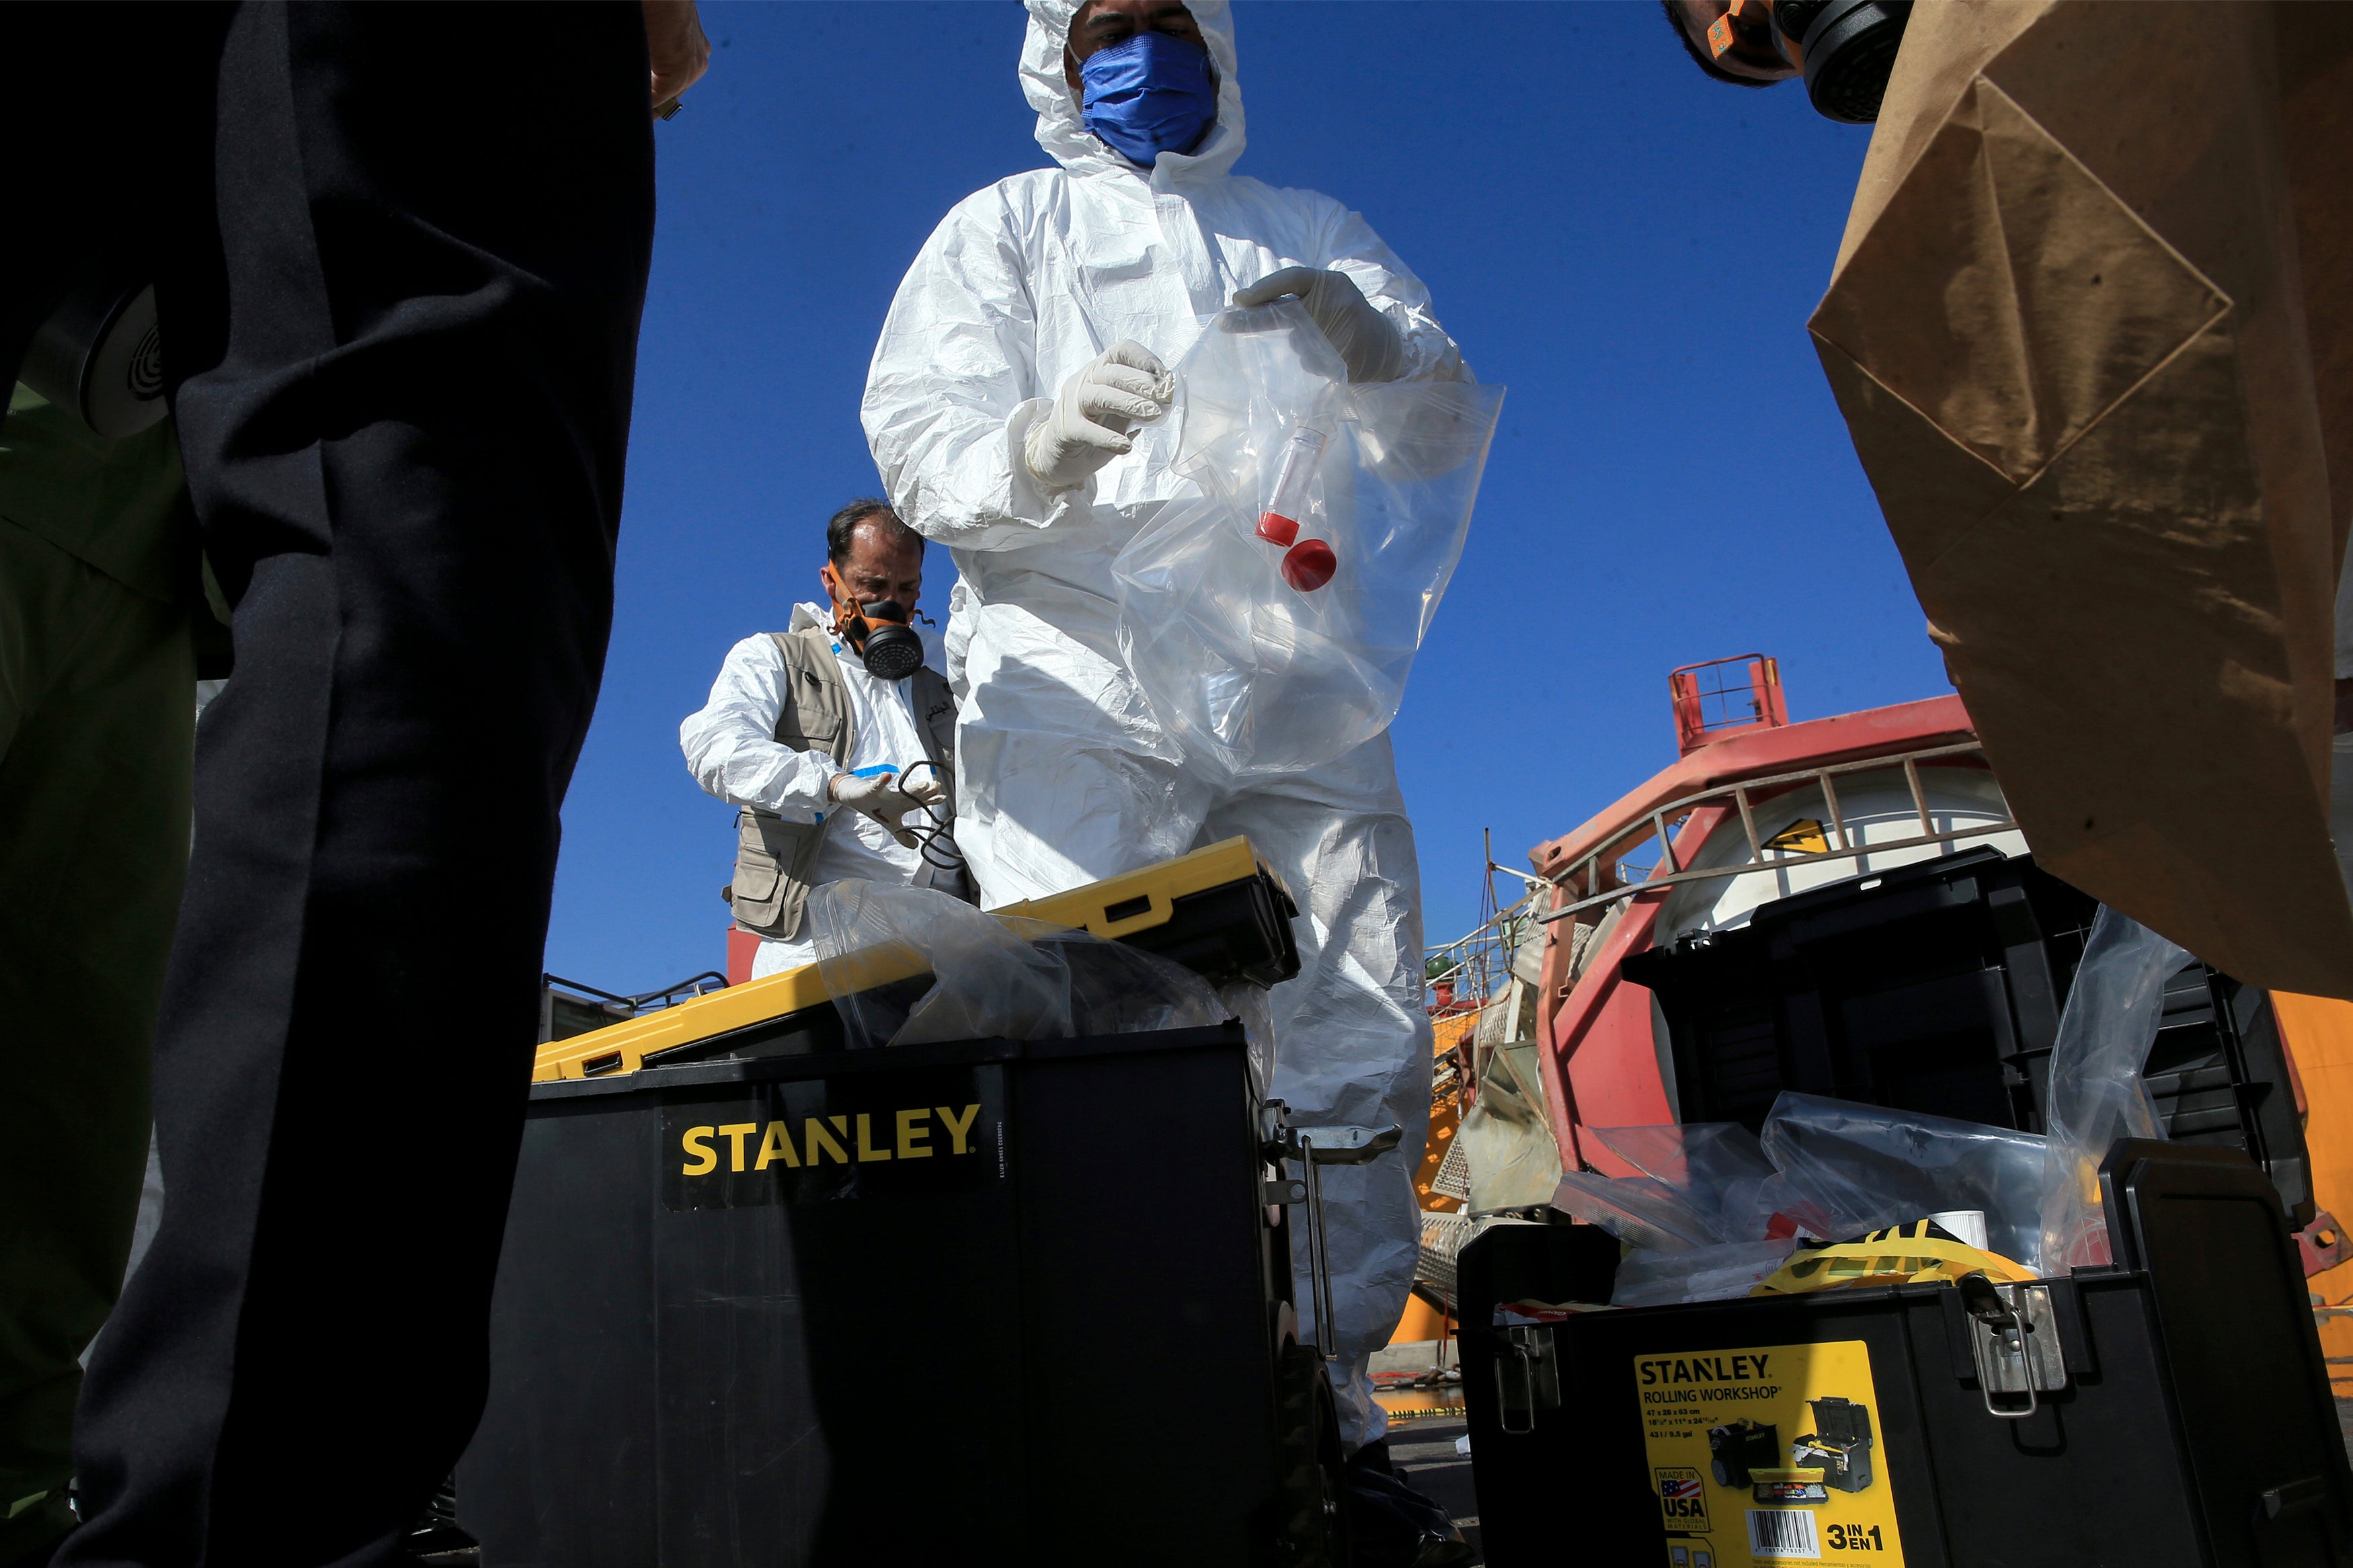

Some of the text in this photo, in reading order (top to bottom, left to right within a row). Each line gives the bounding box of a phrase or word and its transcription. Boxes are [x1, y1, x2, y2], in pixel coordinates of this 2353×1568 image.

[682, 1104, 981, 1175] STANLEY
[1640, 1354, 1769, 1385] STANLEY
[1644, 1386, 1778, 1404] ROLLING WORKSHOP
[1682, 1430, 1693, 1438] gal
[1659, 1471, 1695, 1479] MADE IN
[1663, 1498, 1705, 1518] USA
[1827, 1524, 1884, 1551] 3 IN EN 1
